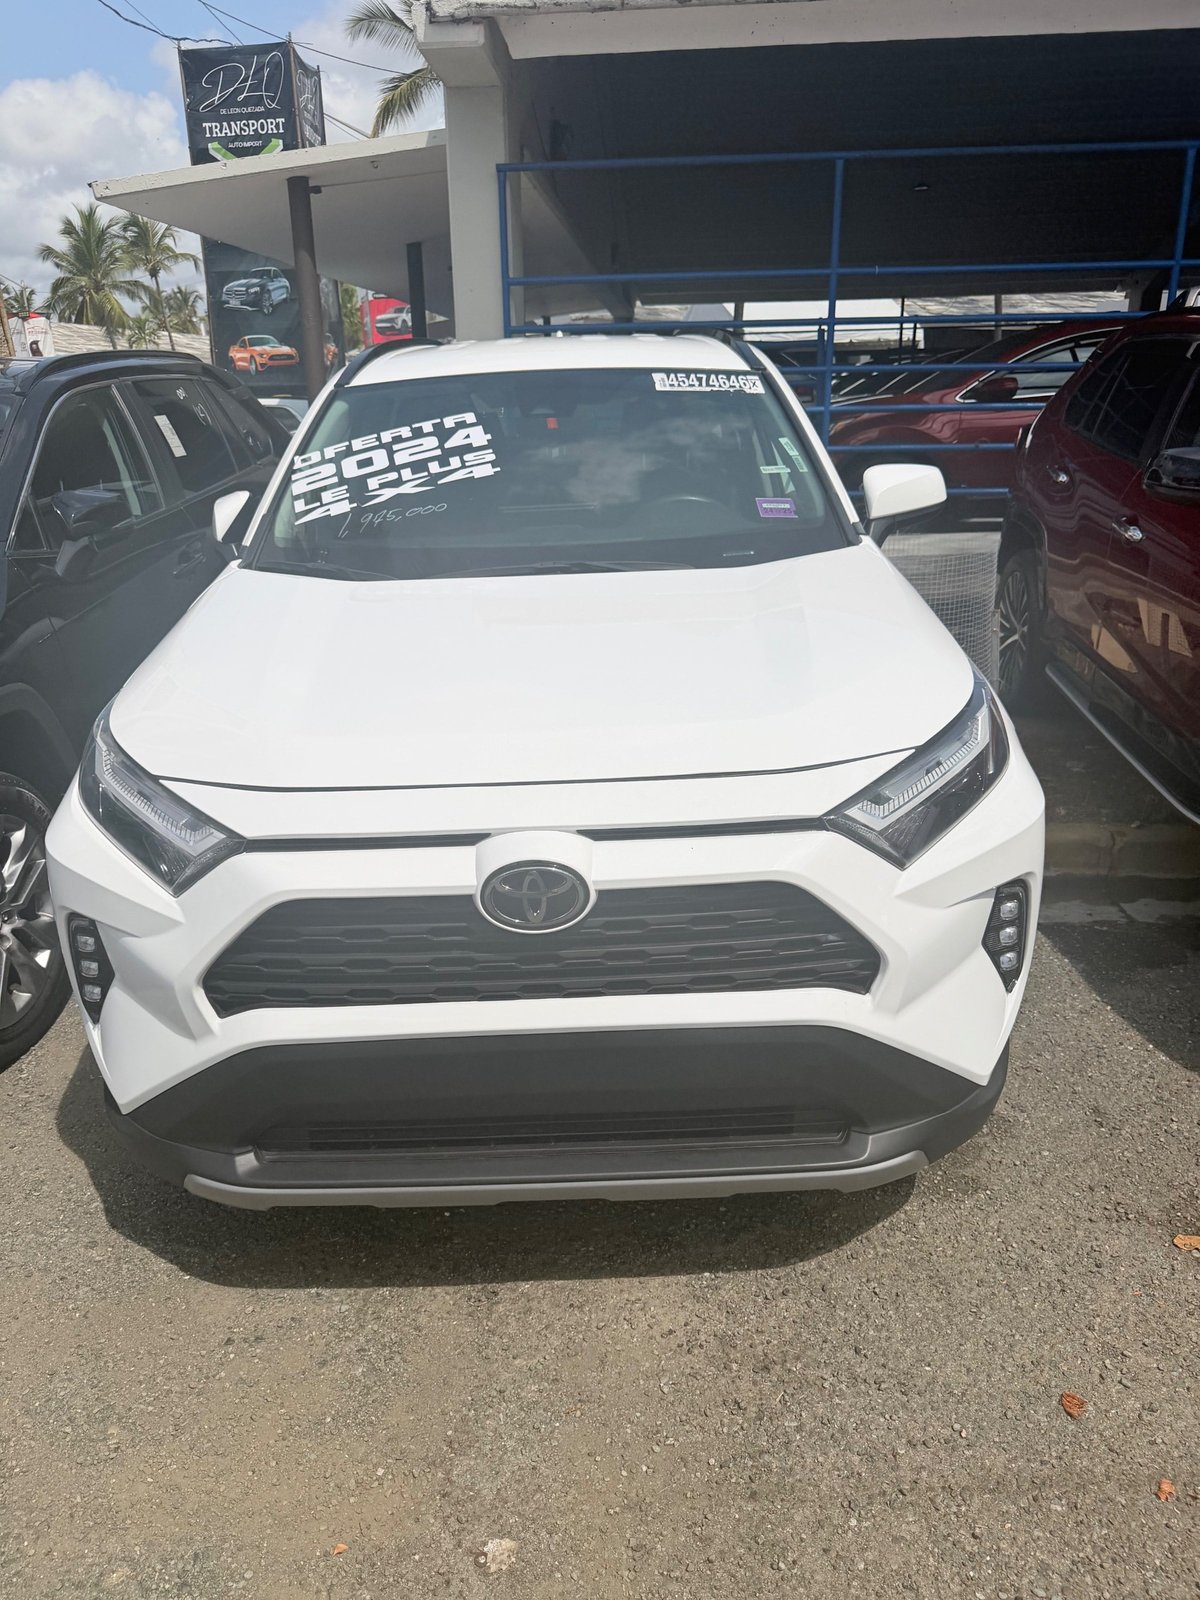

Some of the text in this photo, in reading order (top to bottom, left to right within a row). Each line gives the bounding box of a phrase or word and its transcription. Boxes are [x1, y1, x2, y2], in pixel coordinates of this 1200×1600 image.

[202, 118, 285, 137] TRANSPORT
[241, 105, 265, 114] QUEZADA
[668, 372, 749, 390] 45474646
[293, 411, 478, 470] OFERTA
[291, 425, 492, 496] 2024
[293, 448, 497, 514] LE PLUS
